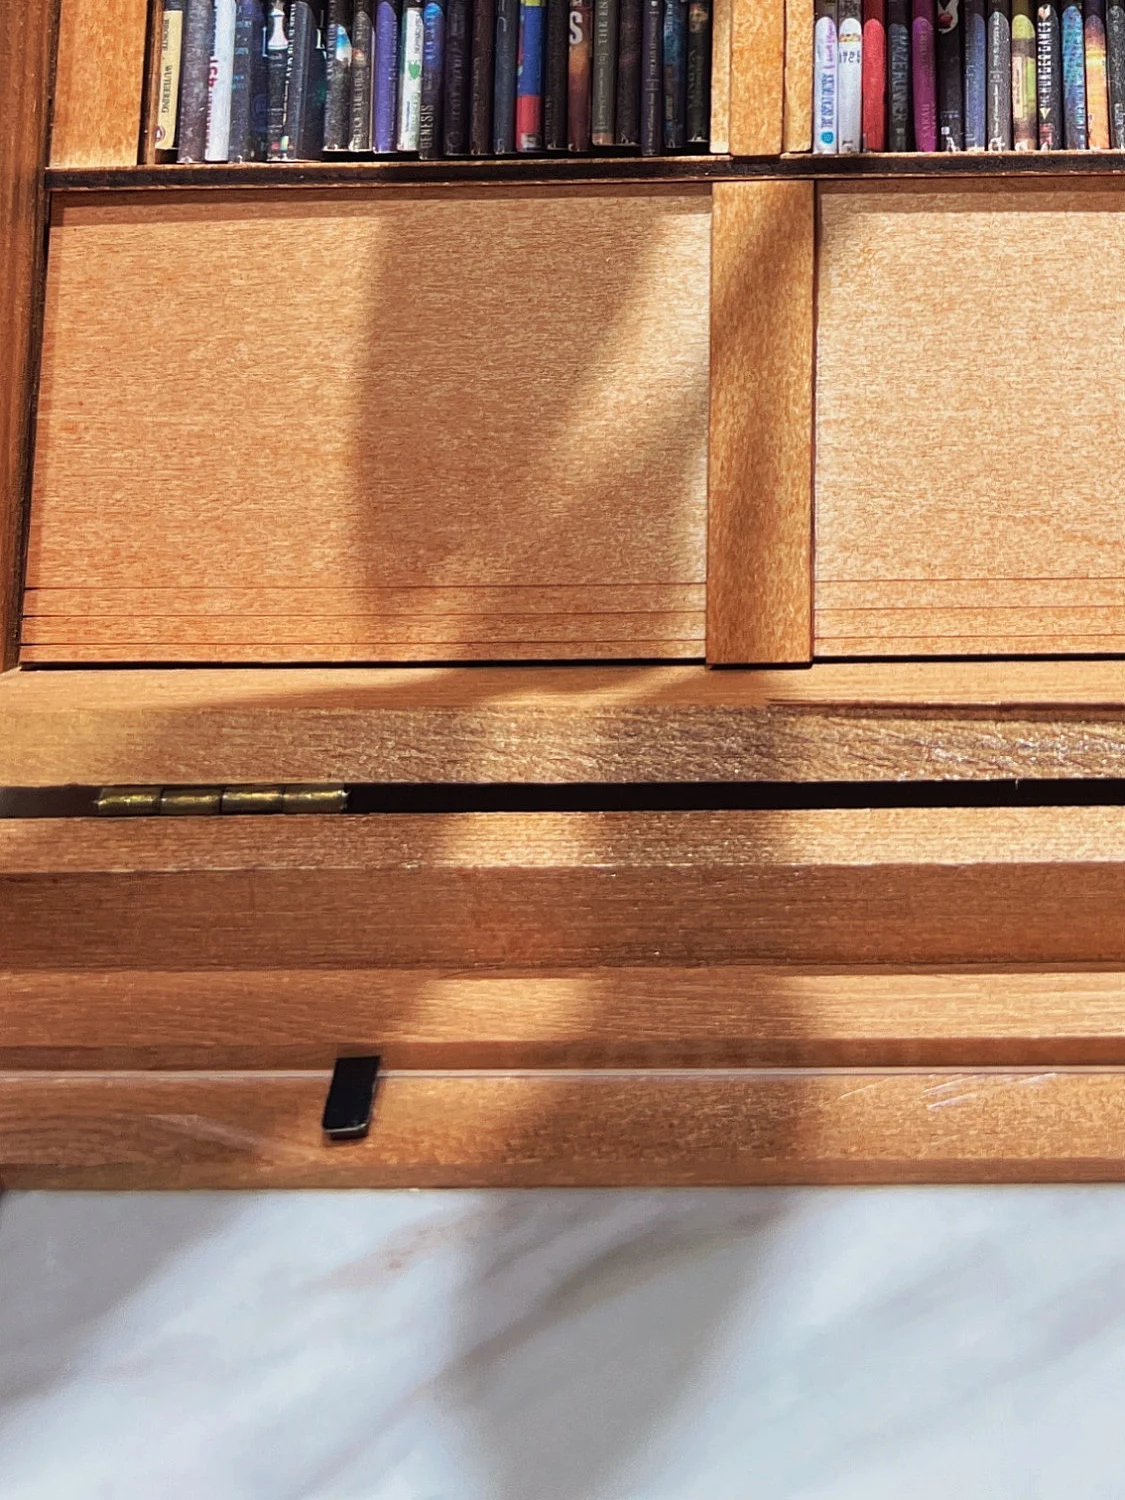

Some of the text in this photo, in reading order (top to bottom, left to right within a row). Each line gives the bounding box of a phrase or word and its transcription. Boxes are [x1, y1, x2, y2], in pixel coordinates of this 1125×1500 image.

[599, 21, 608, 45] THE
[1038, 21, 1051, 52] GAMES
[161, 65, 172, 113] WUTHERING
[892, 35, 908, 122] MAZE RUNNER
[420, 104, 434, 149] GENESIS
